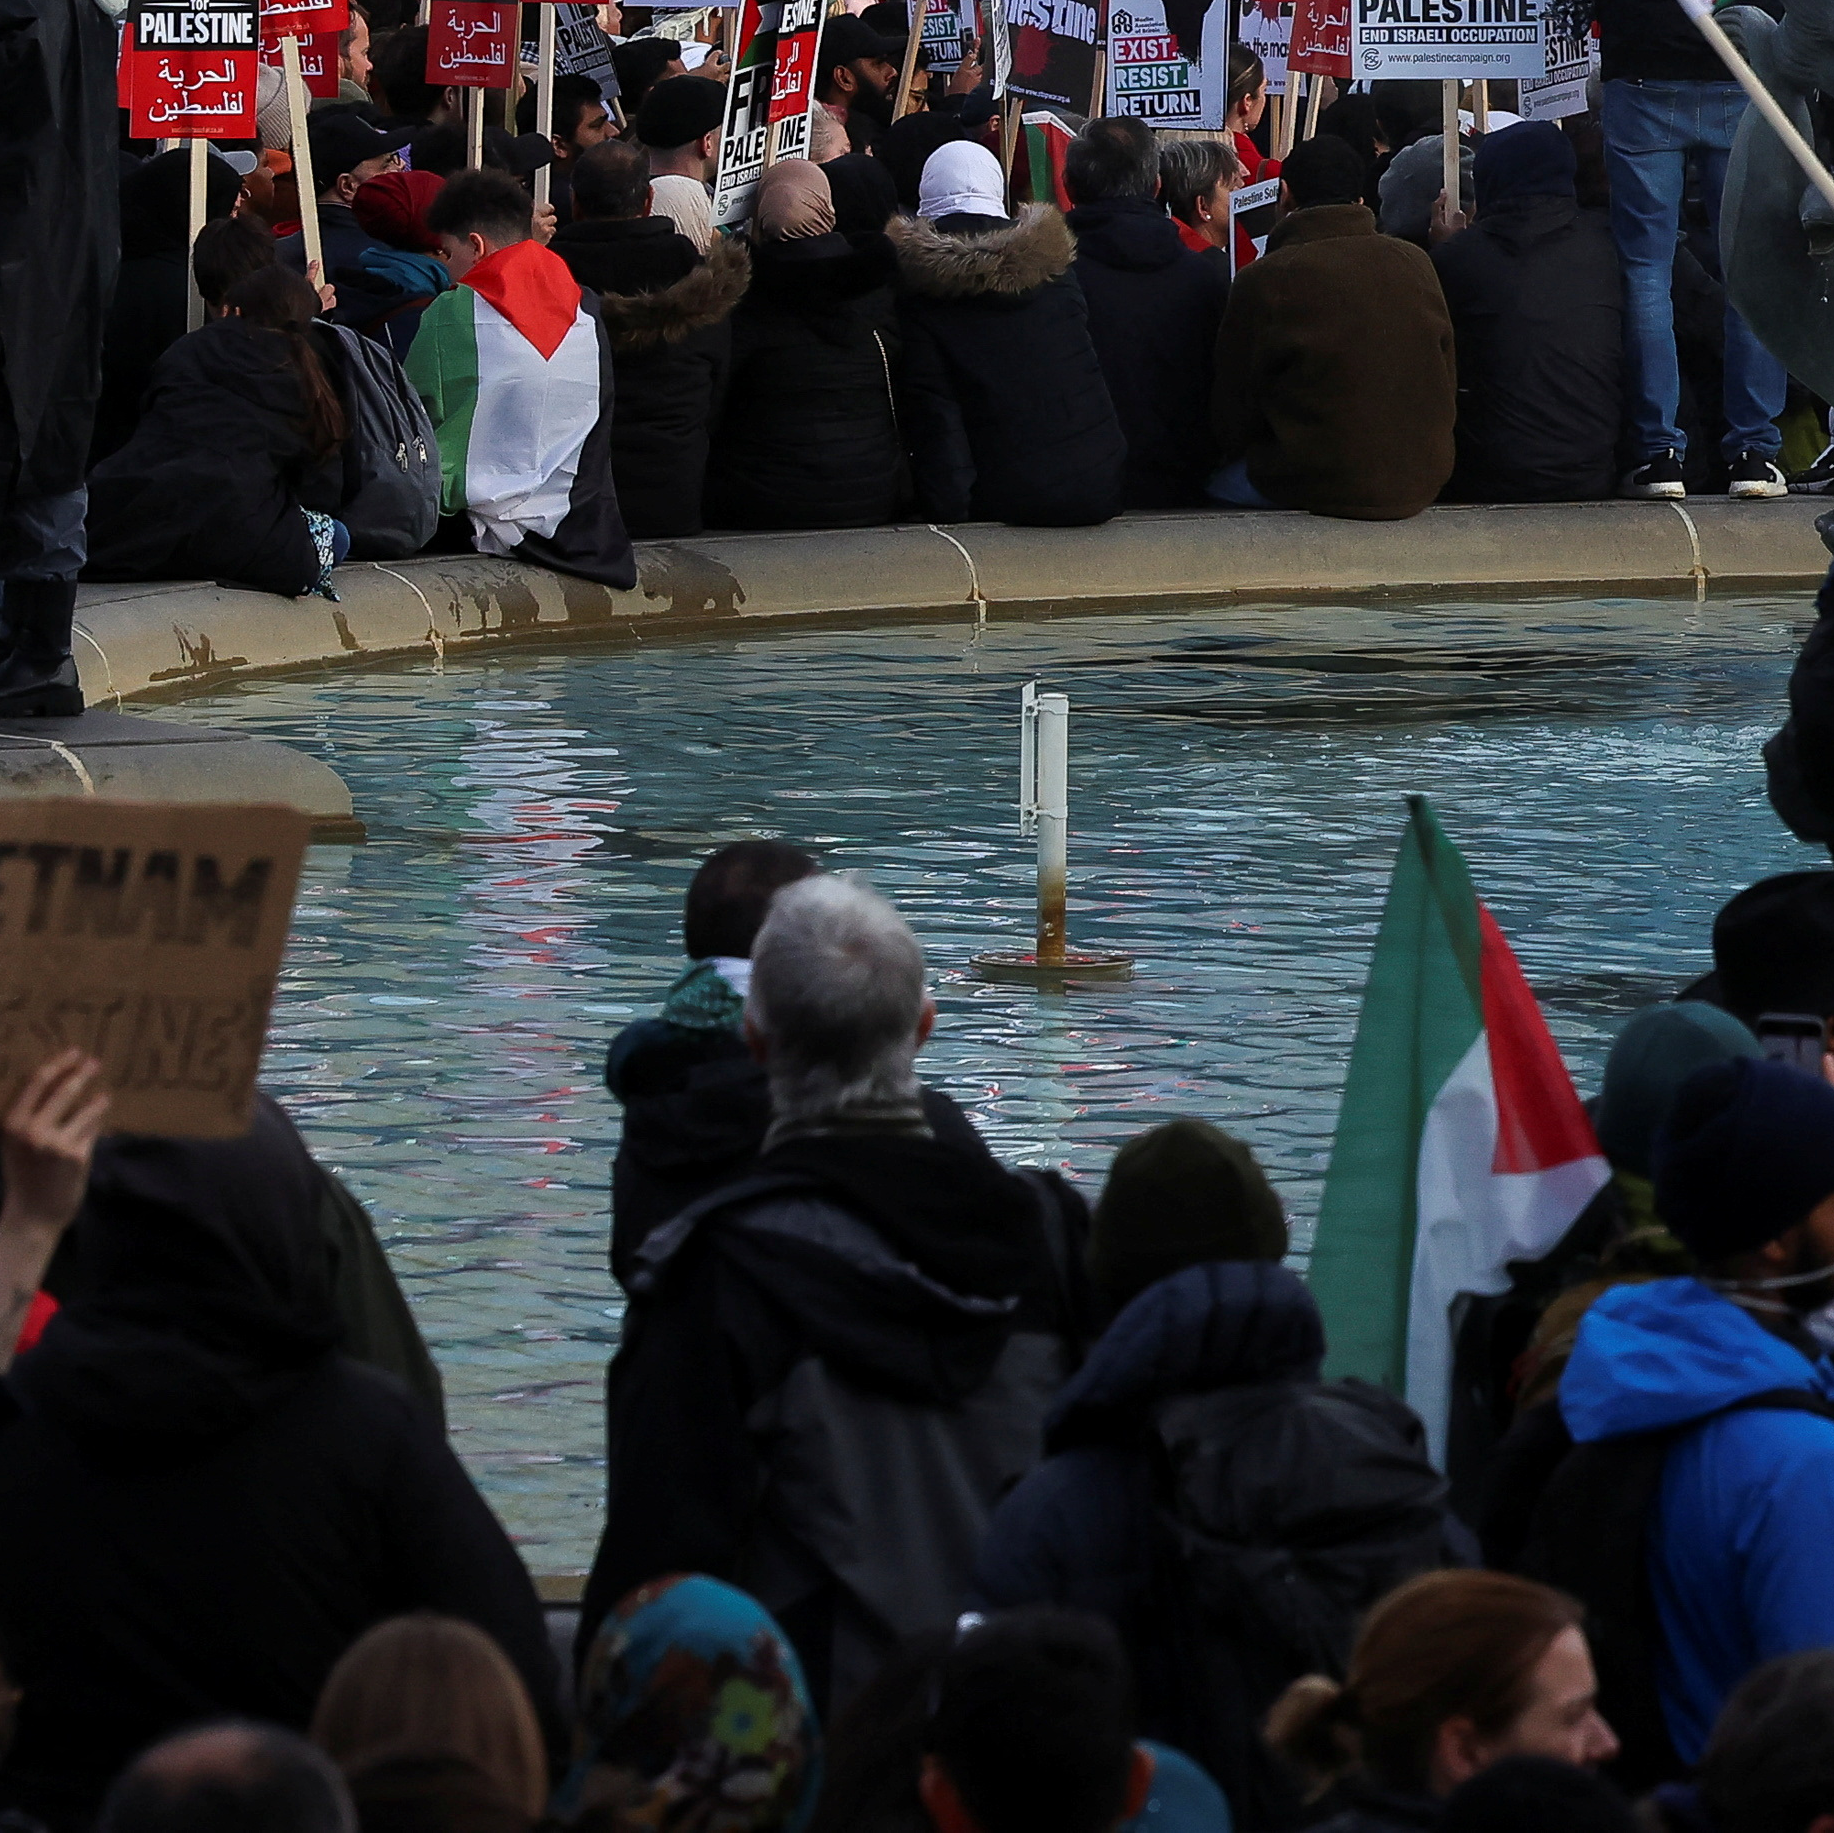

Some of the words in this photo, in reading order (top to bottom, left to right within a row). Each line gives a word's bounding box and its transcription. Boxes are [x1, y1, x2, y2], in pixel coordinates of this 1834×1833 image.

[140, 12, 253, 45] PALESTINE
[446, 11, 501, 38] الحرية
[1361, 28, 1390, 44] END
[1394, 28, 1448, 44] ISRAELI
[1451, 28, 1536, 44] OCCUPATION
[438, 39, 507, 69] لفلسطين
[1114, 37, 1177, 61] EXIST.
[1387, 52, 1511, 68] www.palestinecampaign.org
[157, 59, 236, 91] الحرية
[1115, 65, 1188, 89] RESIST.
[148, 91, 244, 122] لفلسطين
[1117, 92, 1201, 116] RETURN.
